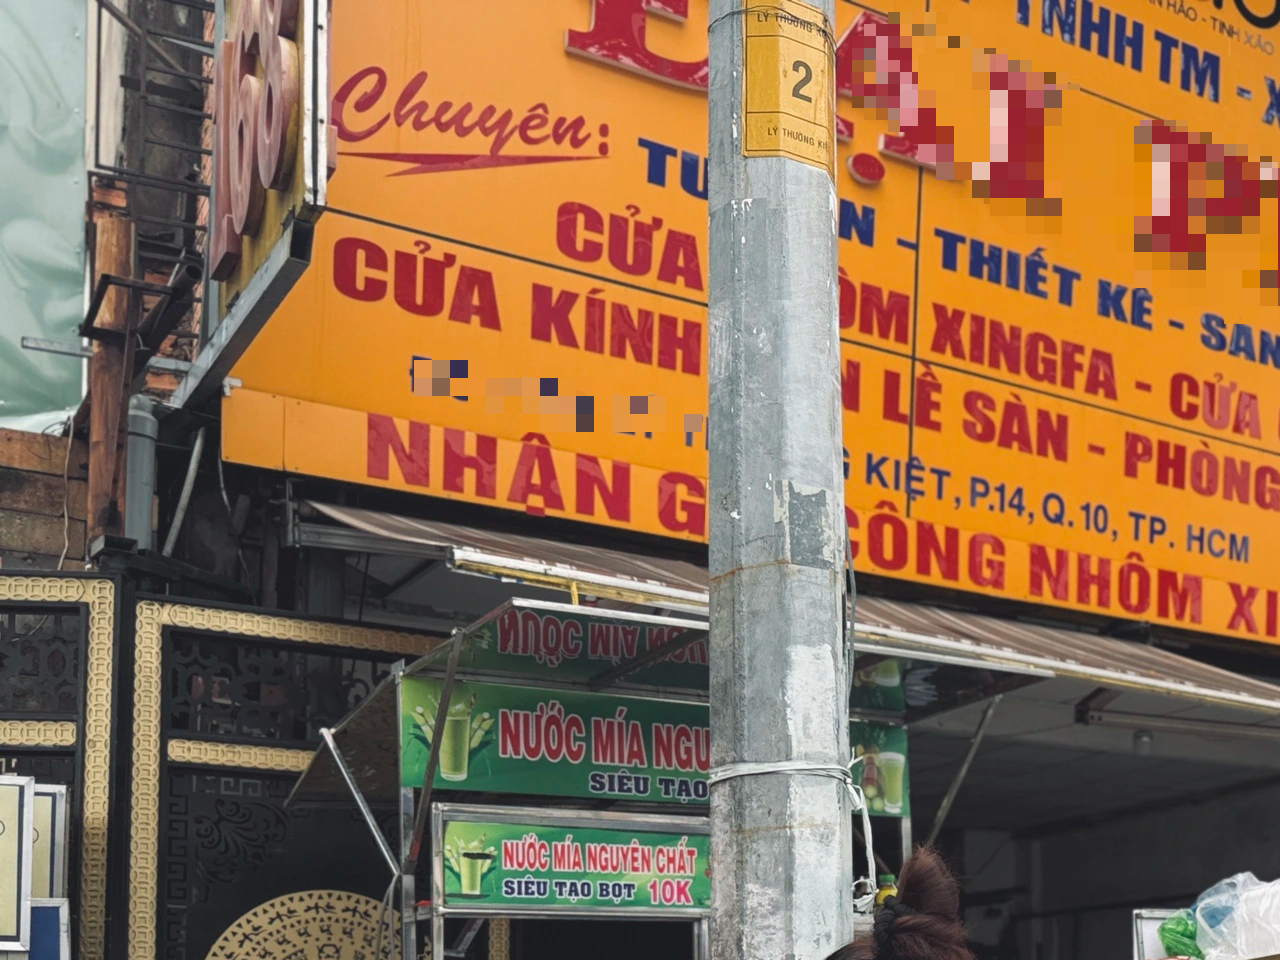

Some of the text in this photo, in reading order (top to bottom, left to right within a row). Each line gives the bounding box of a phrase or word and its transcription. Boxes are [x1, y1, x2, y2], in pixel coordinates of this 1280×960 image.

[791, 59, 813, 104] 2
[1154, 29, 1220, 104] TM
[331, 66, 609, 158] Chuyên:
[767, 126, 779, 136] LÝ
[556, 201, 704, 292] CỬA
[934, 227, 1081, 308] THIẾT
[332, 236, 703, 377] CỬA KÍNH
[930, 301, 1118, 402] XINGFA
[1170, 371, 1262, 441] CỬA
[882, 358, 942, 433] LỀ
[963, 390, 1069, 463] SÀN
[367, 411, 632, 523] NHẬN
[1186, 524, 1250, 565] HCM
[1029, 550, 1203, 625] NHÔM
[500, 700, 586, 764] NƯỚC
[591, 707, 644, 769] MÍA
[589, 768, 650, 796] SIÊU
[501, 833, 697, 877] NƯỚC MÍA NGUYÊN CHẤT
[503, 877, 692, 906] SIÊU TẠO BỌT 10K
